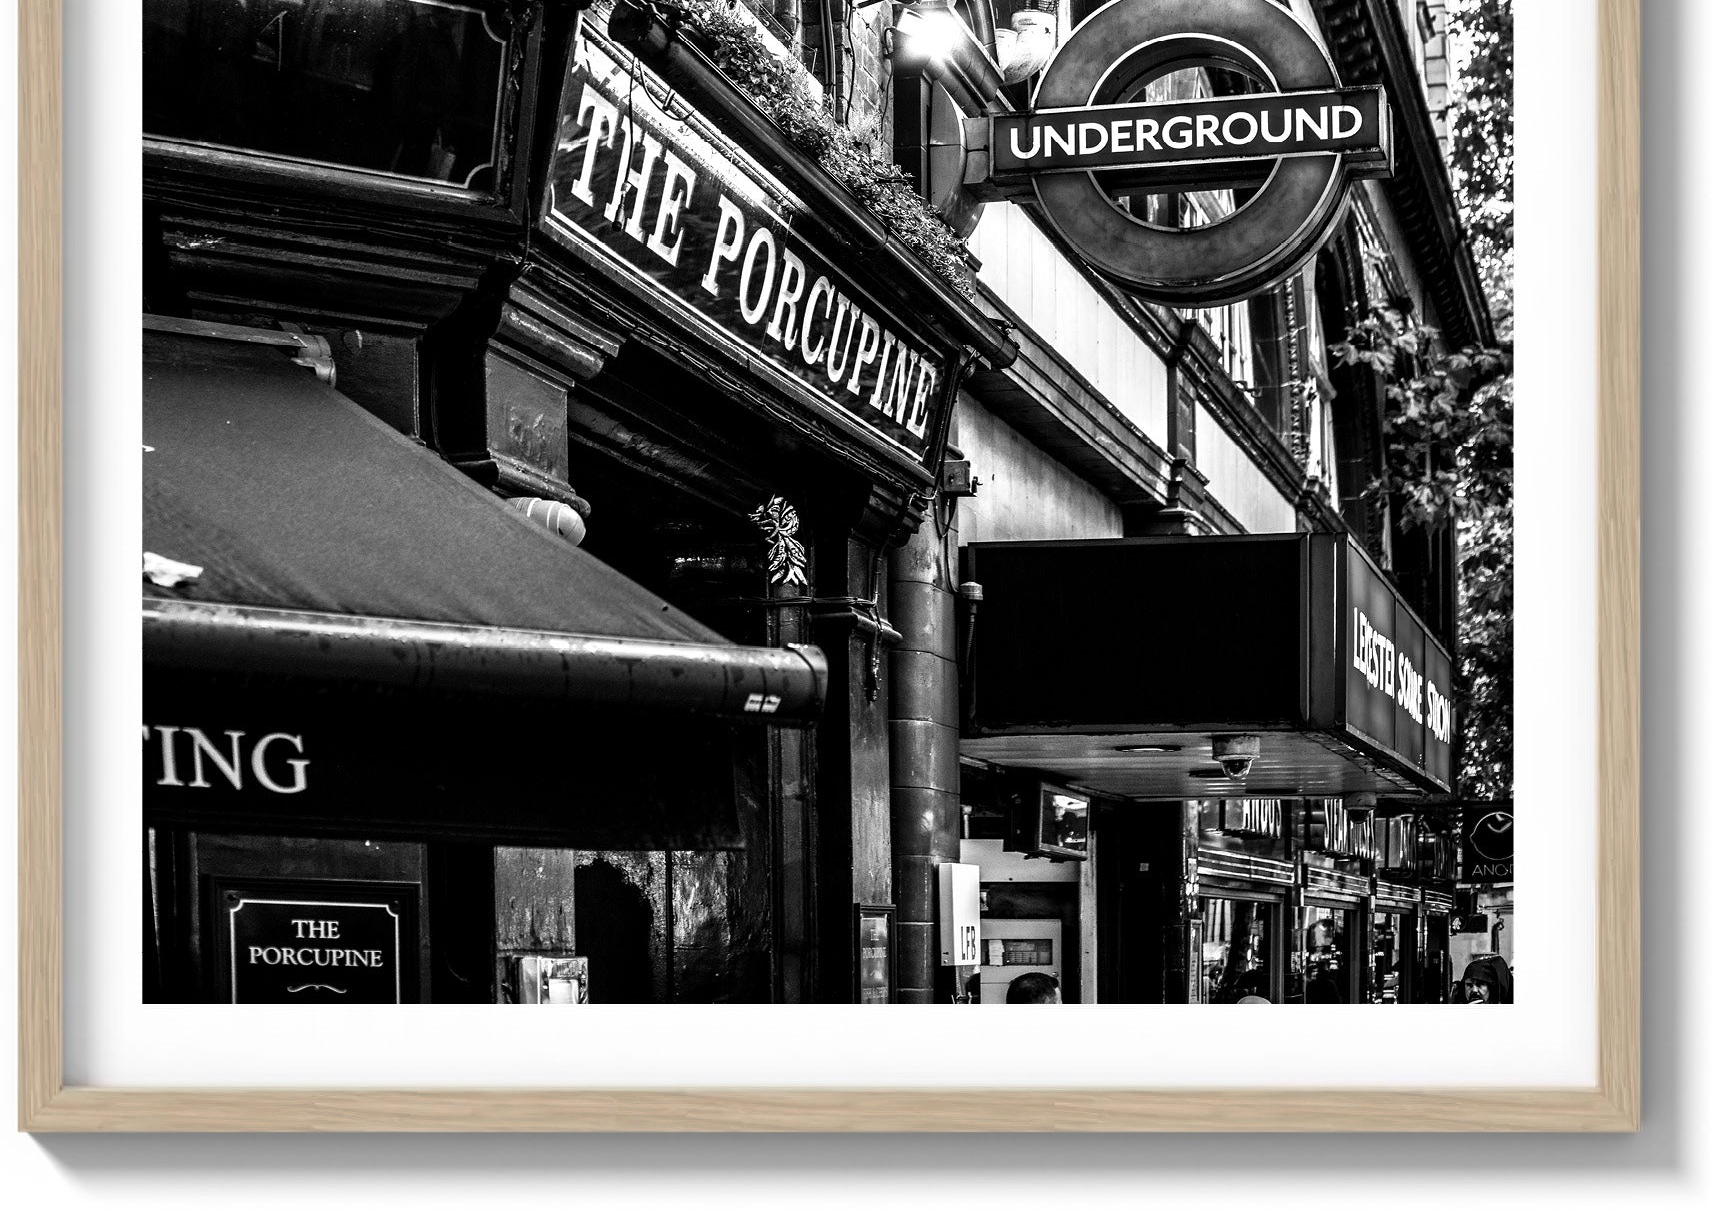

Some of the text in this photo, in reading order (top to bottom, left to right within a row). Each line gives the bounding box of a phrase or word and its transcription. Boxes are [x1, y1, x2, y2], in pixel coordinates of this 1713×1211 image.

[1010, 104, 1363, 160] UNDERGROUND
[570, 83, 938, 440] THE PORCUPINE
[142, 725, 311, 794] ING
[292, 919, 340, 940] THE
[961, 925, 976, 961] LFB
[249, 945, 384, 968] PORCUPINE
